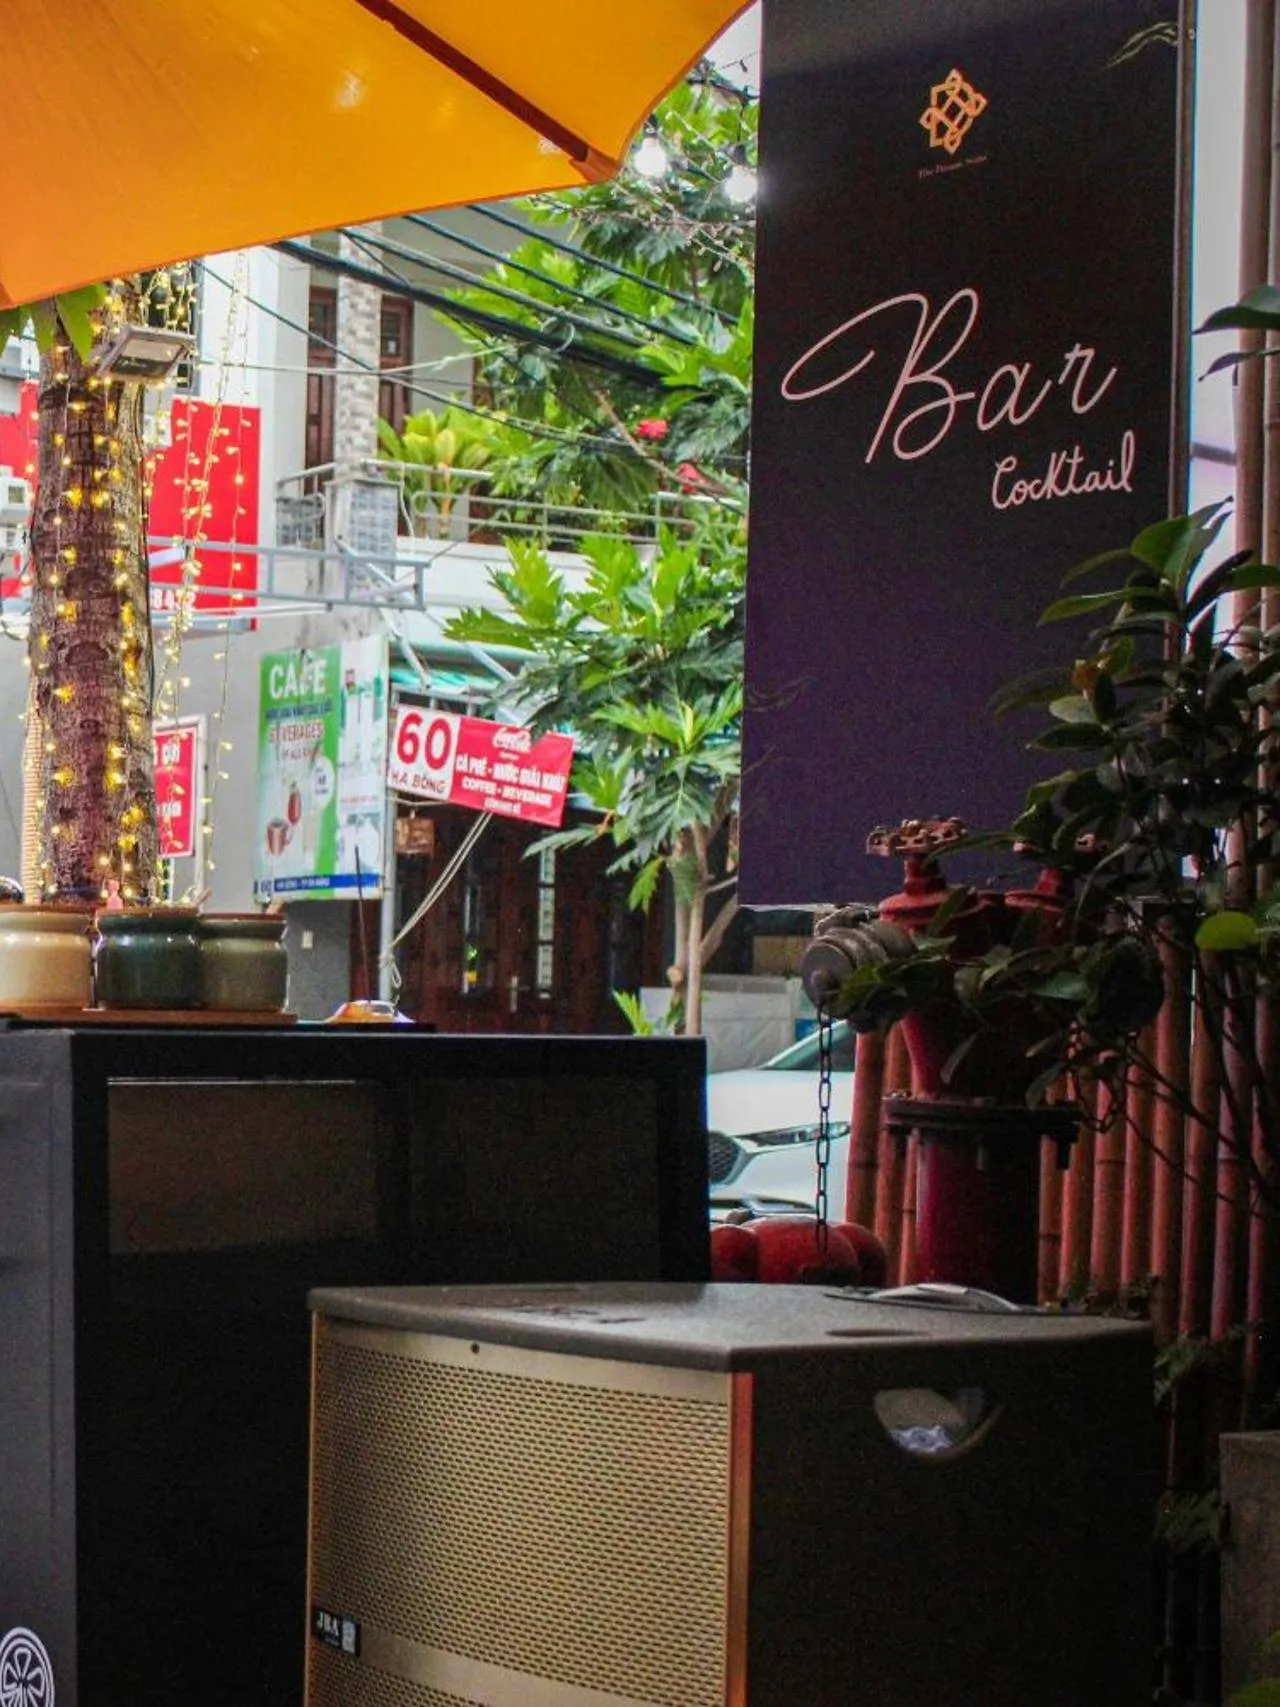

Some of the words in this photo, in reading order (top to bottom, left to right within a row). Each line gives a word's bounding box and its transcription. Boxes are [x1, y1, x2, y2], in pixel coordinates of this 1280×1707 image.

[780, 288, 1117, 464] Bar
[991, 430, 1135, 510] Cocktail
[396, 711, 453, 772] 60
